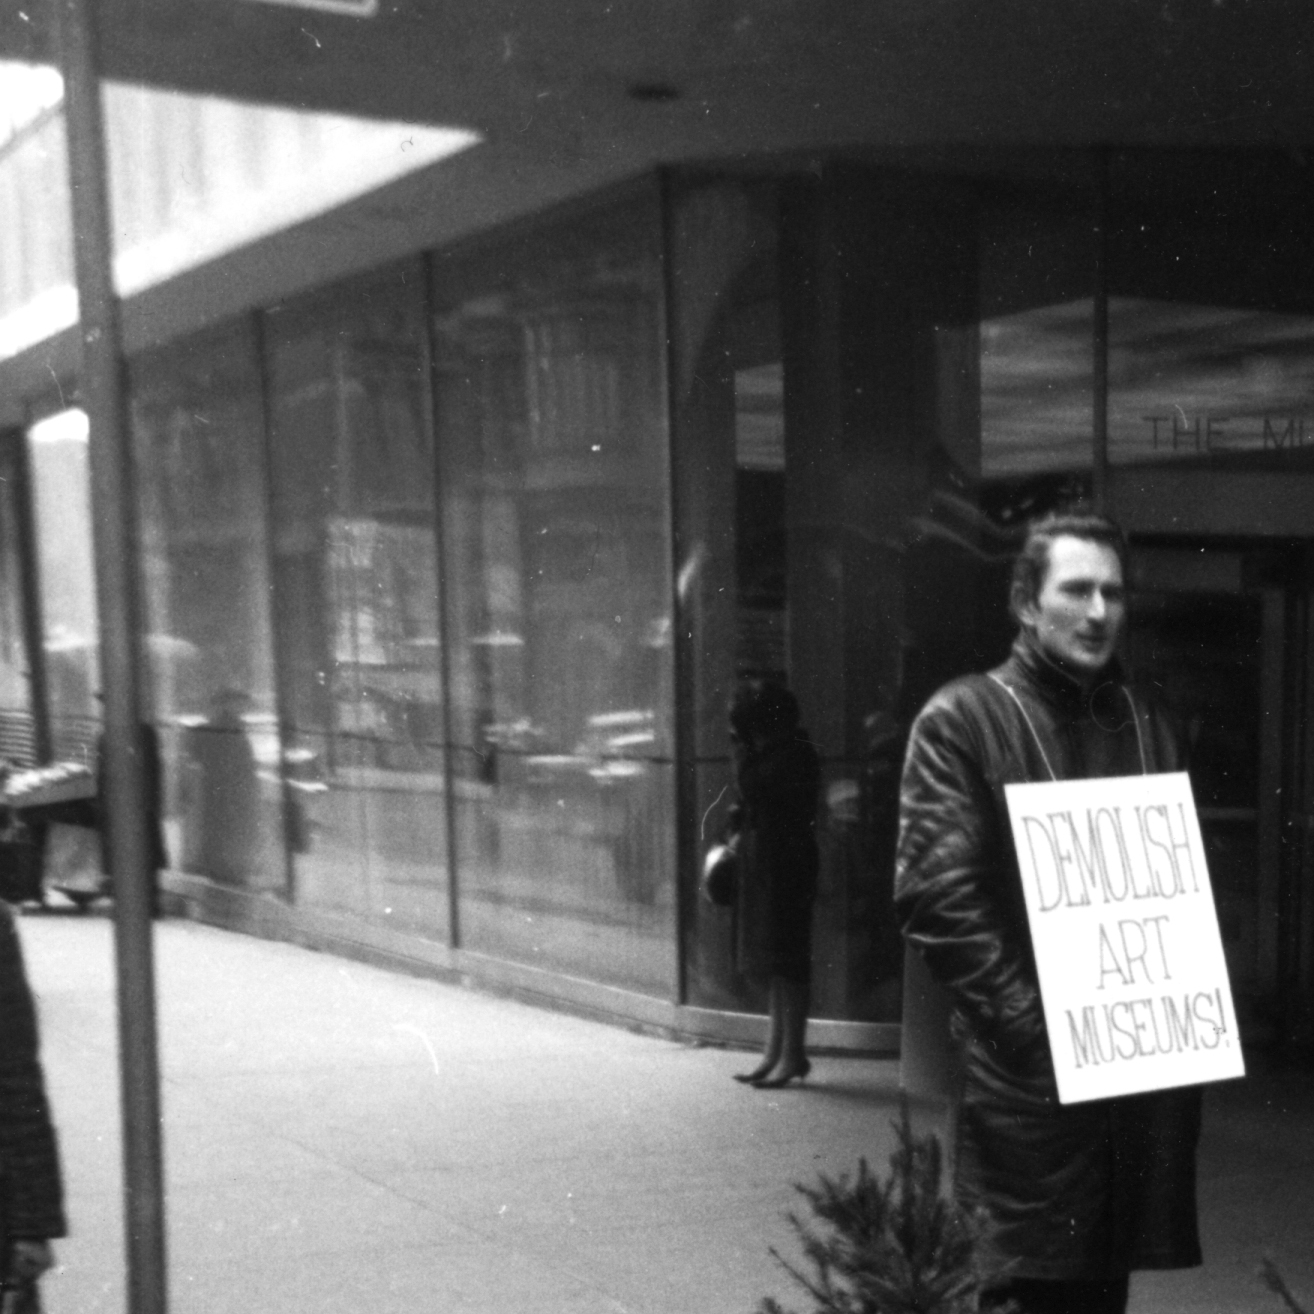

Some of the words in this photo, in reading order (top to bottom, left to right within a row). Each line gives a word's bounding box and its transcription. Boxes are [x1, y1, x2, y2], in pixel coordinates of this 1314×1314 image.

[1141, 416, 1230, 450] THE
[1021, 802, 1201, 913] DEMOLISH
[1096, 914, 1173, 990] ART
[1065, 987, 1231, 1070] MUSEUMS!
